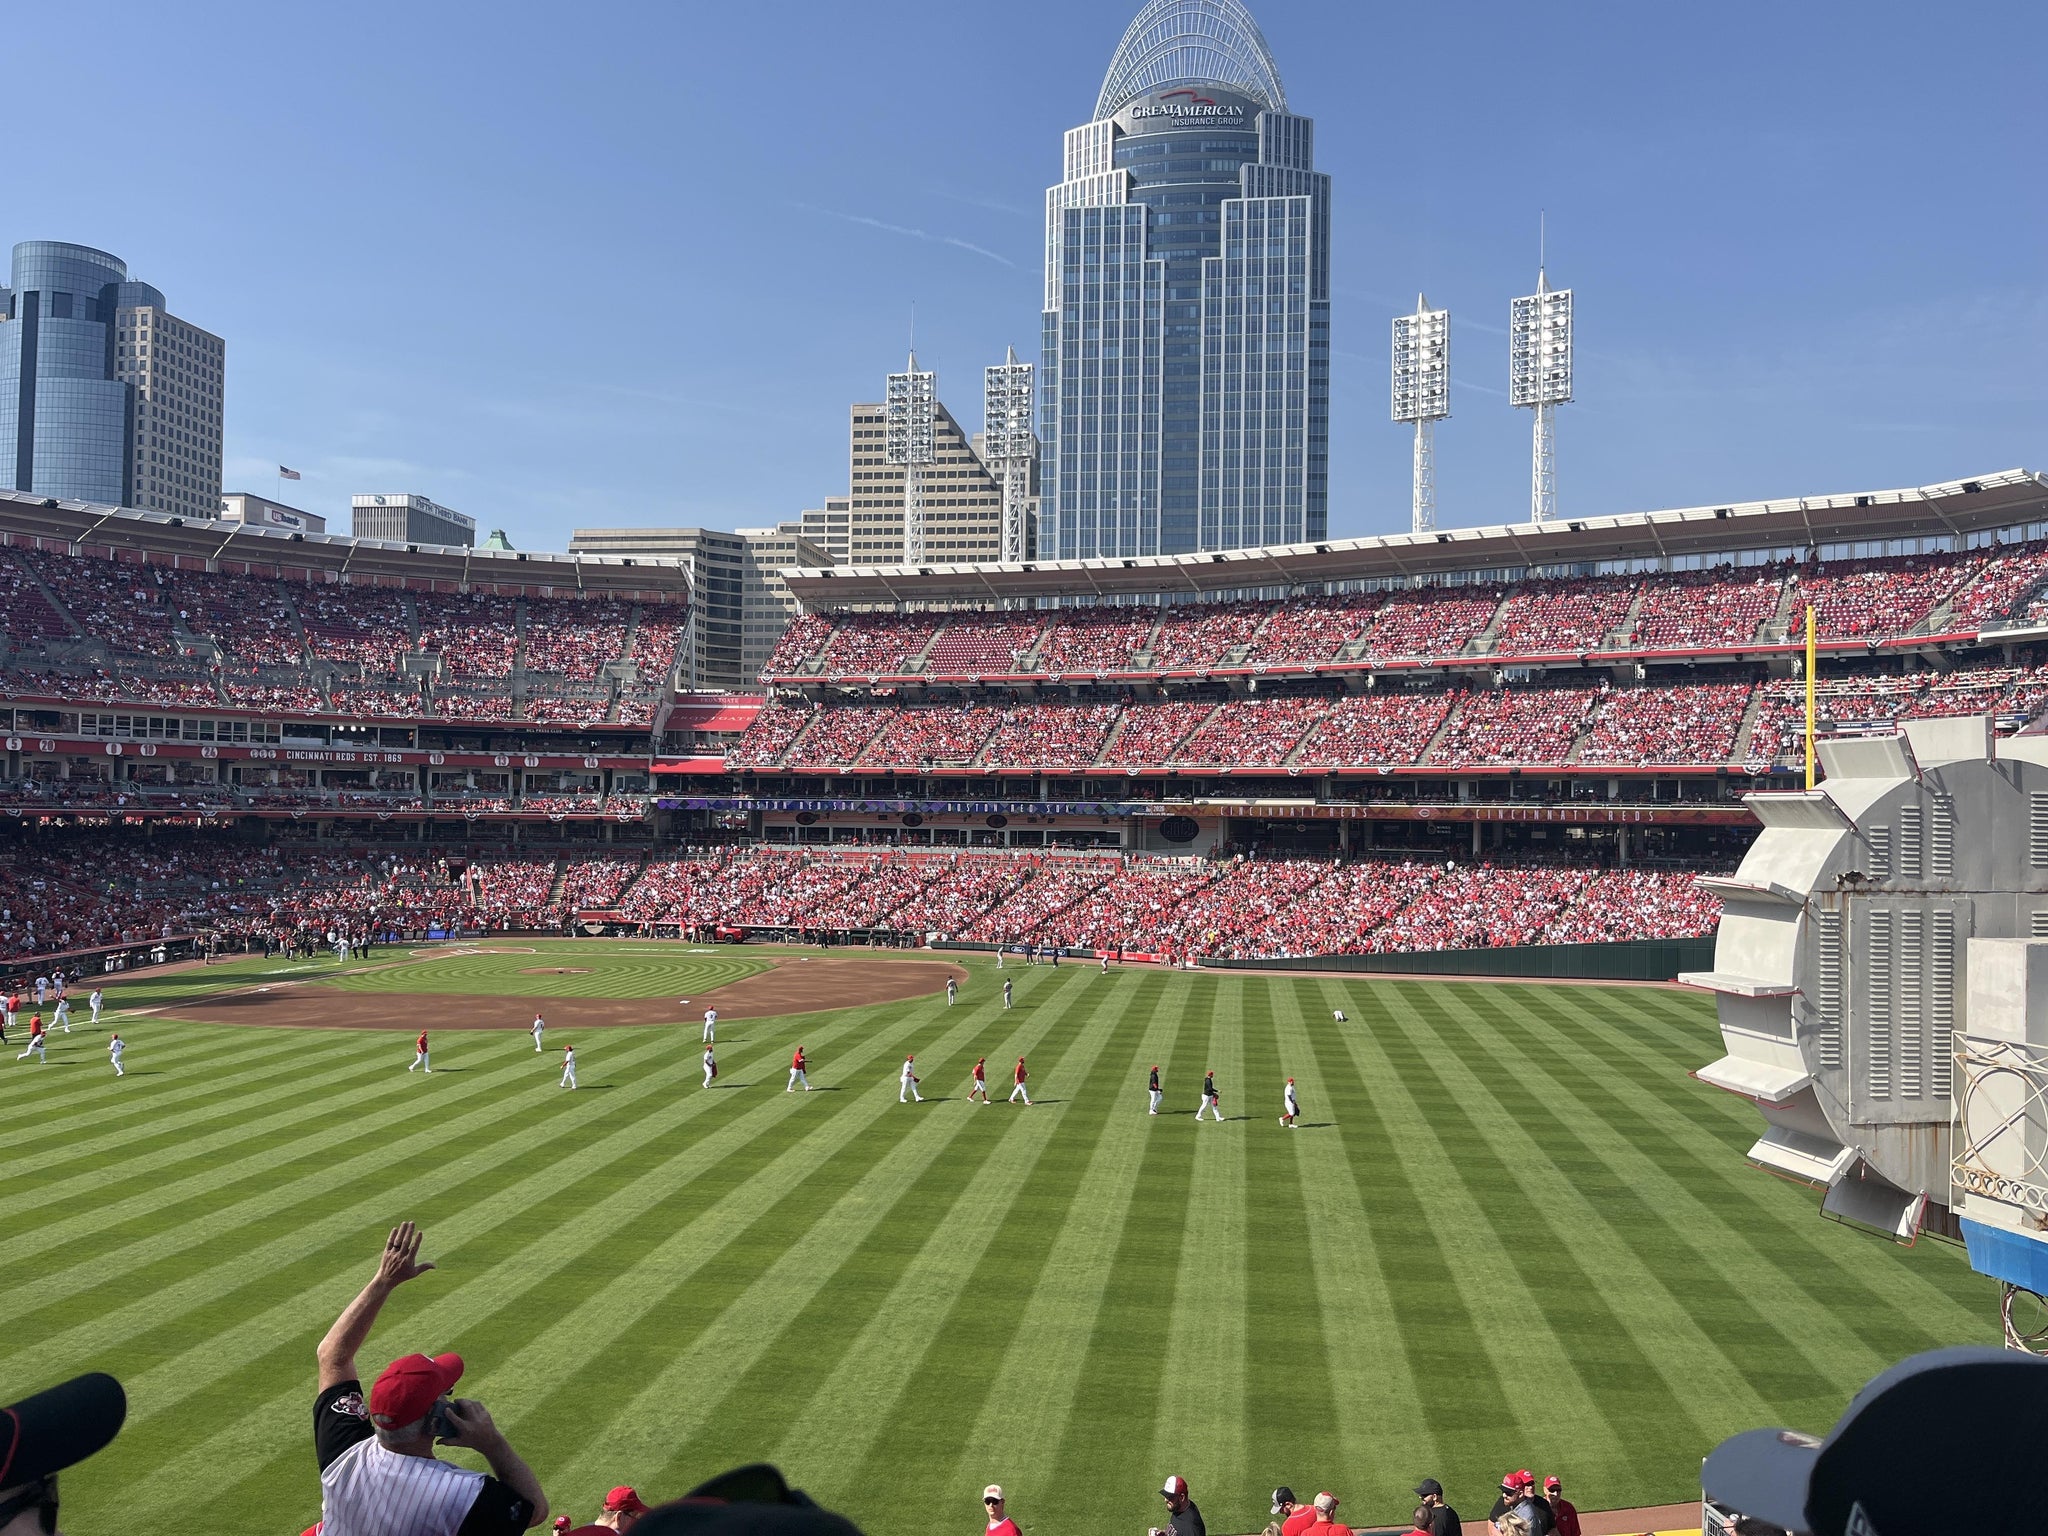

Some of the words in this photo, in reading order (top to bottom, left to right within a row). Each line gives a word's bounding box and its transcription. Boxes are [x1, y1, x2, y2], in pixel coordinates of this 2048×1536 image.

[1171, 118, 1215, 127] INSURANCE
[1217, 118, 1244, 126] GROUP
[416, 497, 433, 513] FIFTH
[434, 506, 452, 519] THIRD
[453, 513, 469, 526] BANK
[11, 738, 18, 749] 5
[41, 740, 53, 751] 20
[286, 750, 333, 761] CINCINNATI
[335, 752, 356, 761] REDS
[363, 754, 381, 762] EST.
[384, 754, 402, 763] 1869
[738, 801, 787, 810] BOSTON
[799, 801, 821, 810] RED
[833, 801, 855, 811] SOX
[947, 803, 998, 813] BOSTON
[1010, 803, 1033, 813] RED
[1046, 804, 1070, 813] SOX
[1220, 805, 1315, 817] CINCINNATI
[1329, 807, 1368, 818] REDS
[1476, 809, 1589, 821] CINCINNATI
[1608, 810, 1654, 822] REDS
